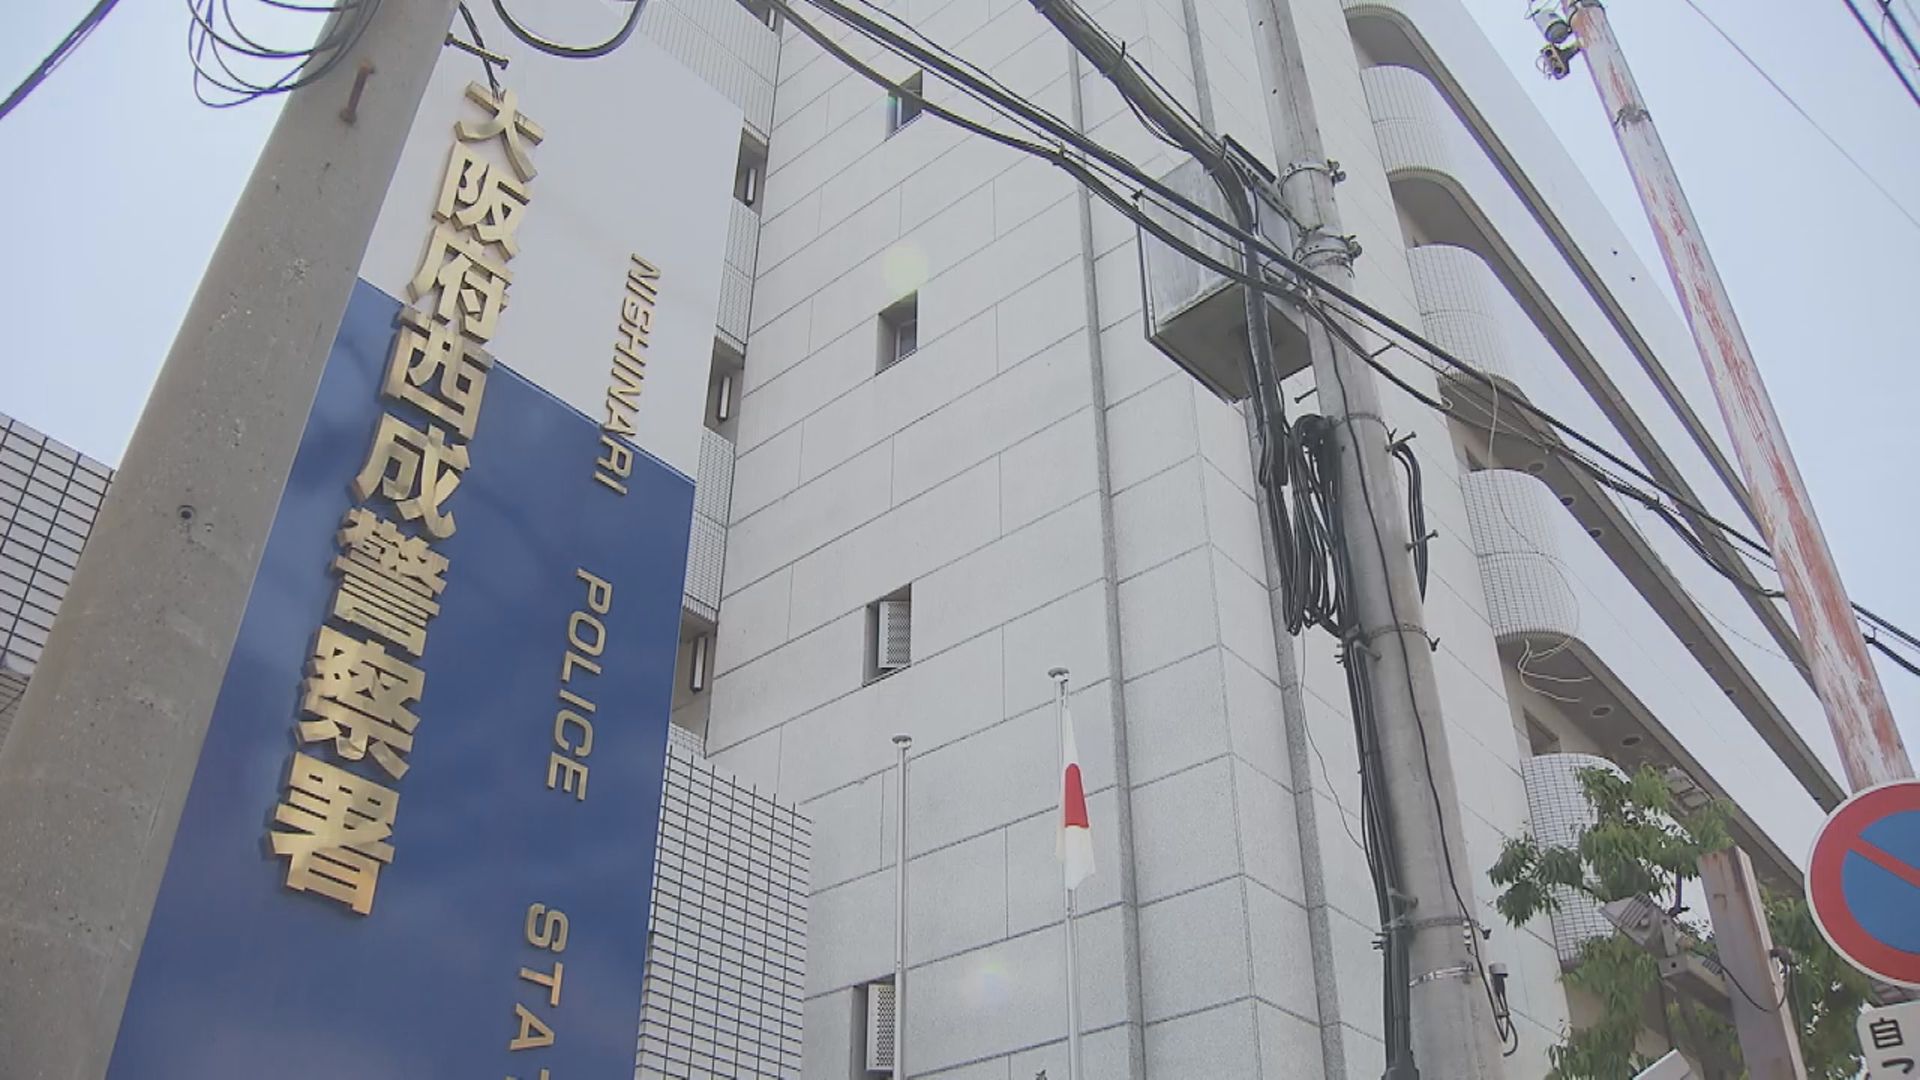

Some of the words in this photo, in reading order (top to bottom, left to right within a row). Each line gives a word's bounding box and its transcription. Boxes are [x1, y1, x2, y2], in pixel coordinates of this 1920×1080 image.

[592, 253, 662, 495] NISHINARI
[269, 81, 545, 915] 大阪府西成警察署
[546, 567, 613, 801] POLICE
[506, 903, 569, 1080] STA
